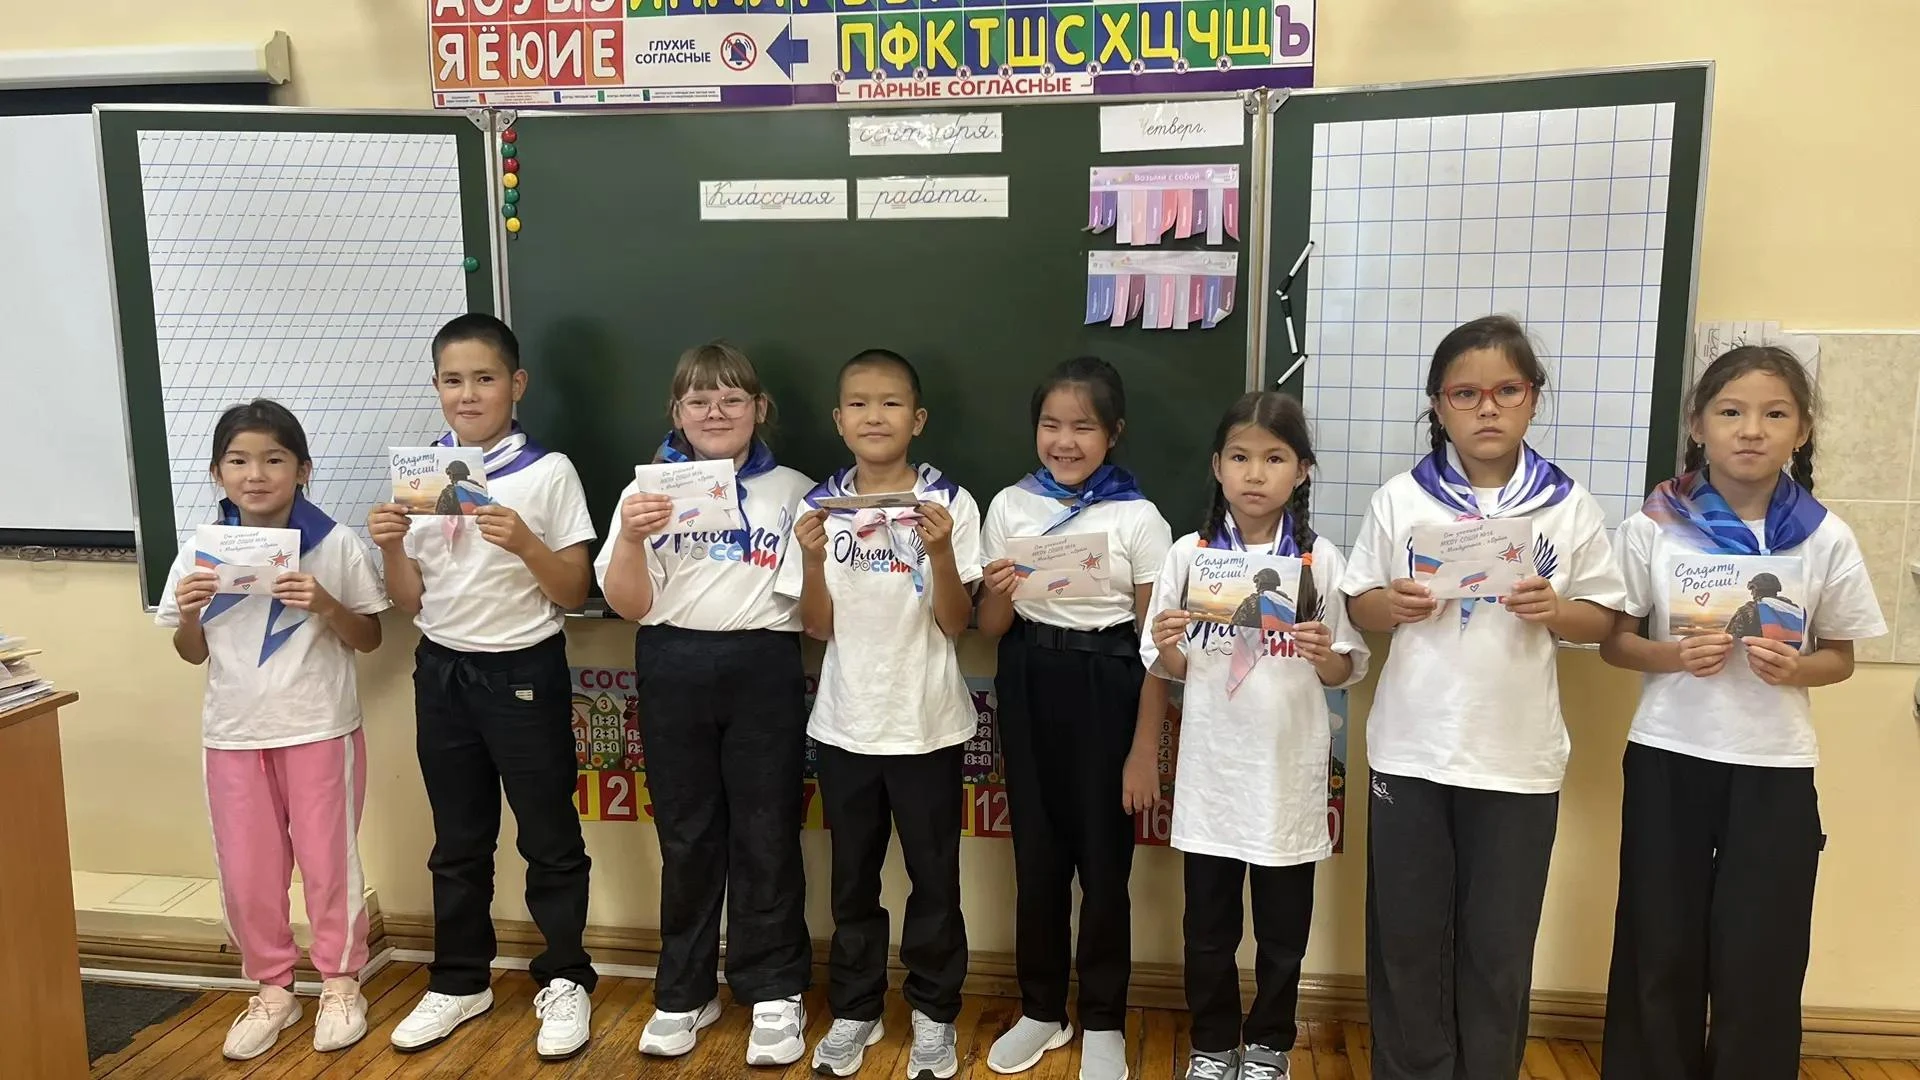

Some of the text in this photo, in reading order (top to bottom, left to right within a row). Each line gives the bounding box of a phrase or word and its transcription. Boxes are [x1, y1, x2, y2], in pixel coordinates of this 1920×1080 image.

[649, 39, 696, 51] ГЛУХИЕ
[635, 52, 711, 64] СОГЛАСНЫЕ
[858, 78, 1072, 99] ПАРНЫЕ СОГЛАСНЫЕ
[392, 453, 435, 468] Солдату
[398, 459, 440, 479] России!
[1195, 553, 1245, 568] Солдату
[1199, 564, 1249, 581] России!
[1675, 562, 1735, 578] Солдату
[1682, 571, 1740, 593] России!
[607, 775, 631, 816] 2
[976, 790, 1012, 832] 12
